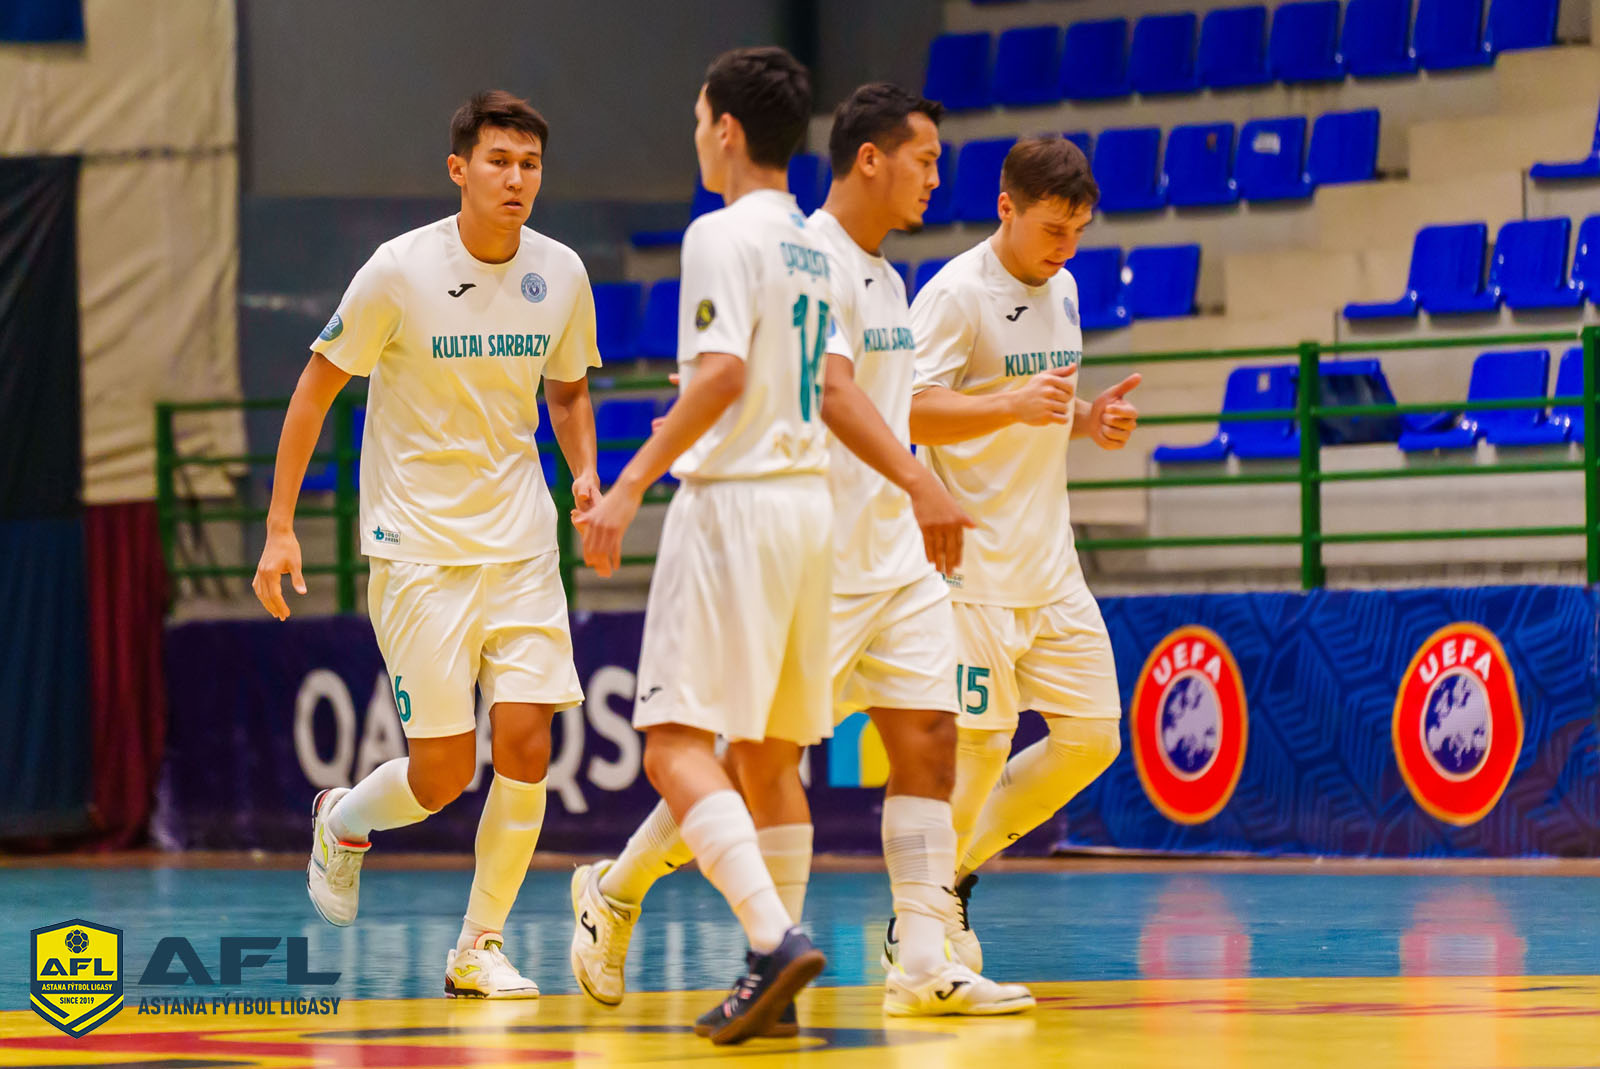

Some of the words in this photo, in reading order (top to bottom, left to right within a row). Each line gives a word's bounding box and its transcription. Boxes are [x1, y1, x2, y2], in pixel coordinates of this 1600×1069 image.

[432, 335, 482, 359] KULTAI
[488, 334, 550, 357] SARBAZY
[1152, 641, 1221, 686] UEFA
[1419, 638, 1491, 684] UEFA
[395, 675, 411, 723] 6
